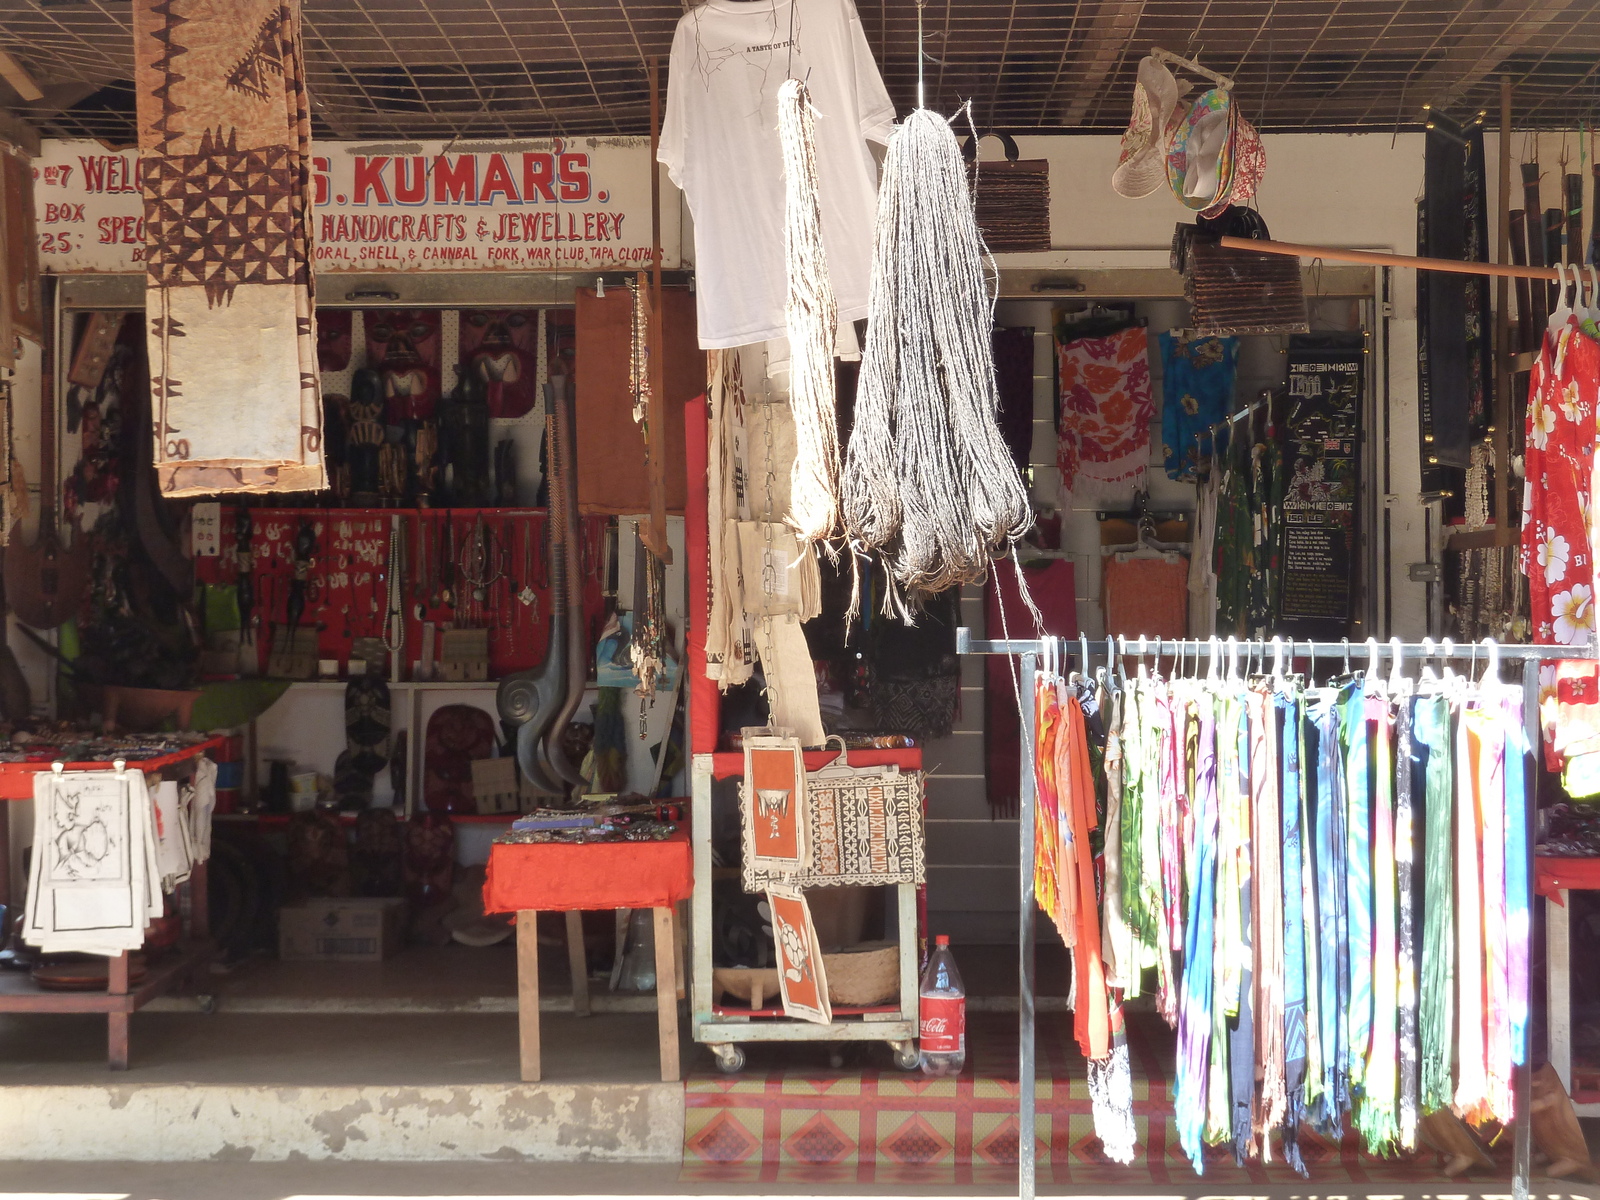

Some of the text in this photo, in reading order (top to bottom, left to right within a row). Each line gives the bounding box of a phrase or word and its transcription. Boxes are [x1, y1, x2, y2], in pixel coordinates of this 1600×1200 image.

[45, 202, 85, 224] BOX
[98, 216, 146, 244] SPEC
[321, 211, 625, 243] HANDICRAFTS & JEWELLERY
[315, 246, 357, 263] ORAL,
[359, 245, 406, 263] SHELL,
[407, 248, 418, 261] &
[487, 246, 525, 263] FORK,
[526, 246, 551, 261] WAR
[555, 247, 589, 263] CLUB,
[589, 246, 614, 260] TAPA
[618, 246, 664, 261] CLOTHS
